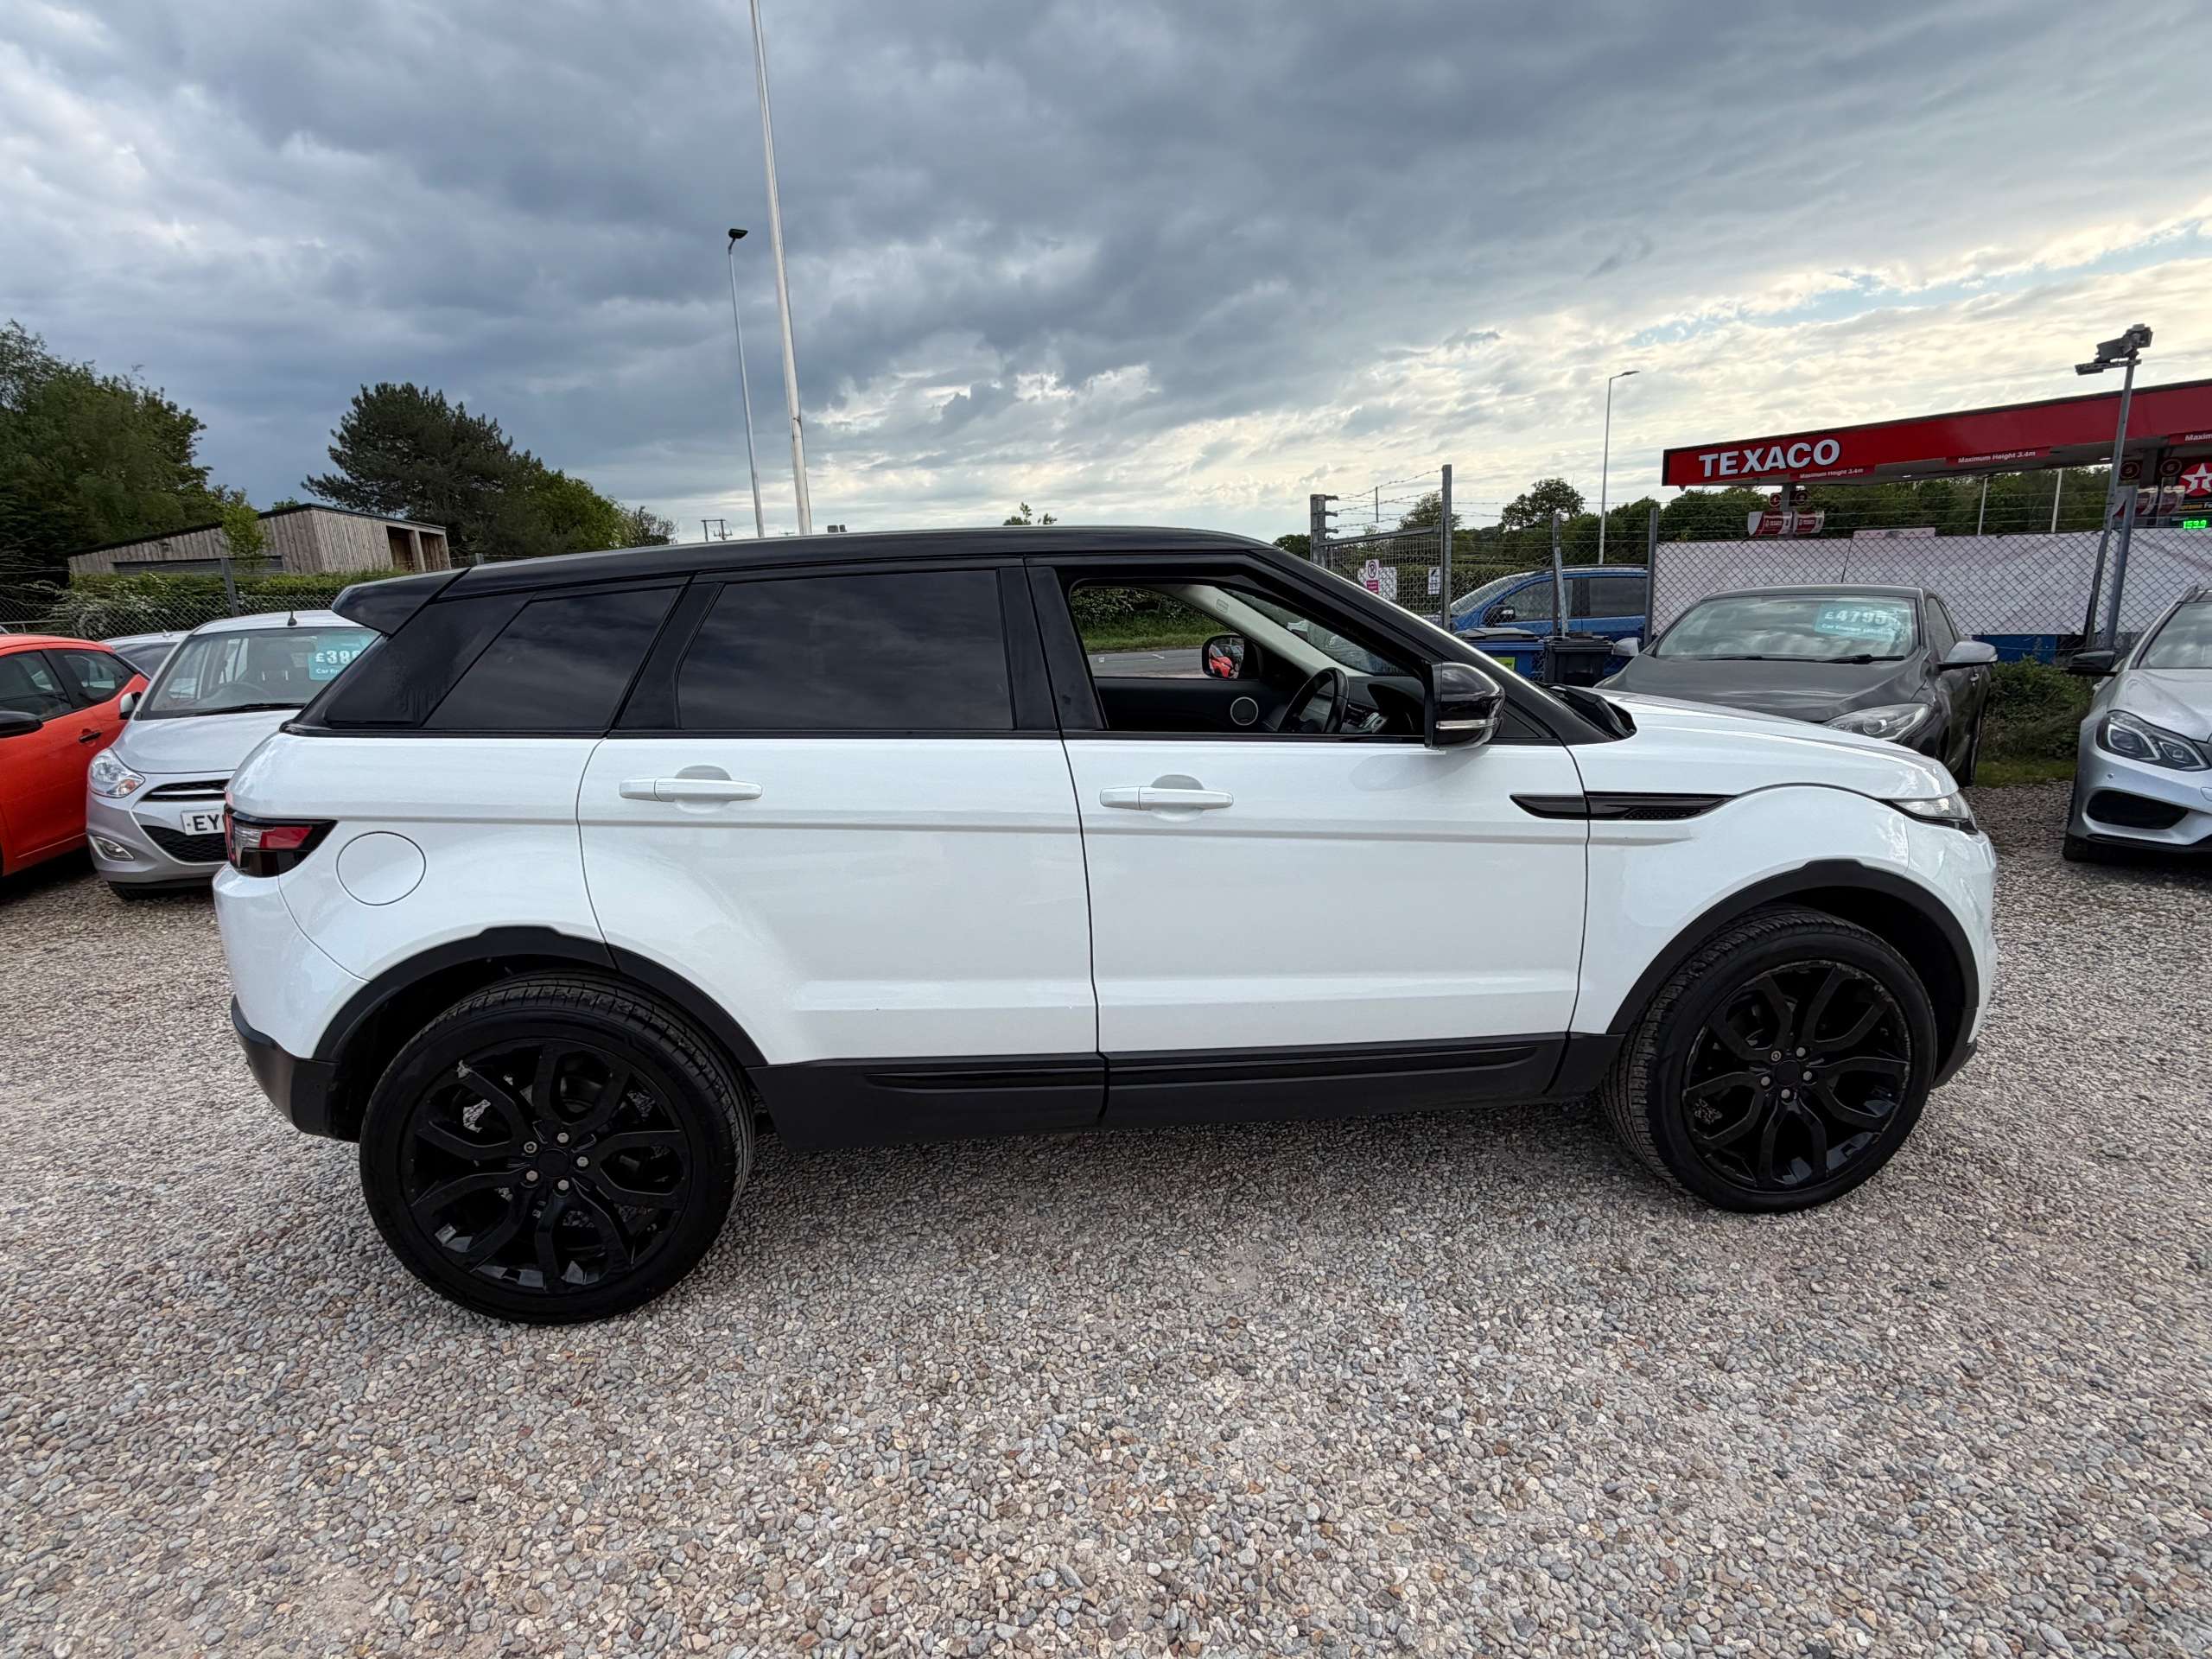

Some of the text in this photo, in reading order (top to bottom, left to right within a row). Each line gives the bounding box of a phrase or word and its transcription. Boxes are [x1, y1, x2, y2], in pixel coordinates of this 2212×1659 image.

[1699, 439, 1840, 477] TEXACO
[1824, 609, 1886, 625] £4795
[193, 814, 225, 831] EY
